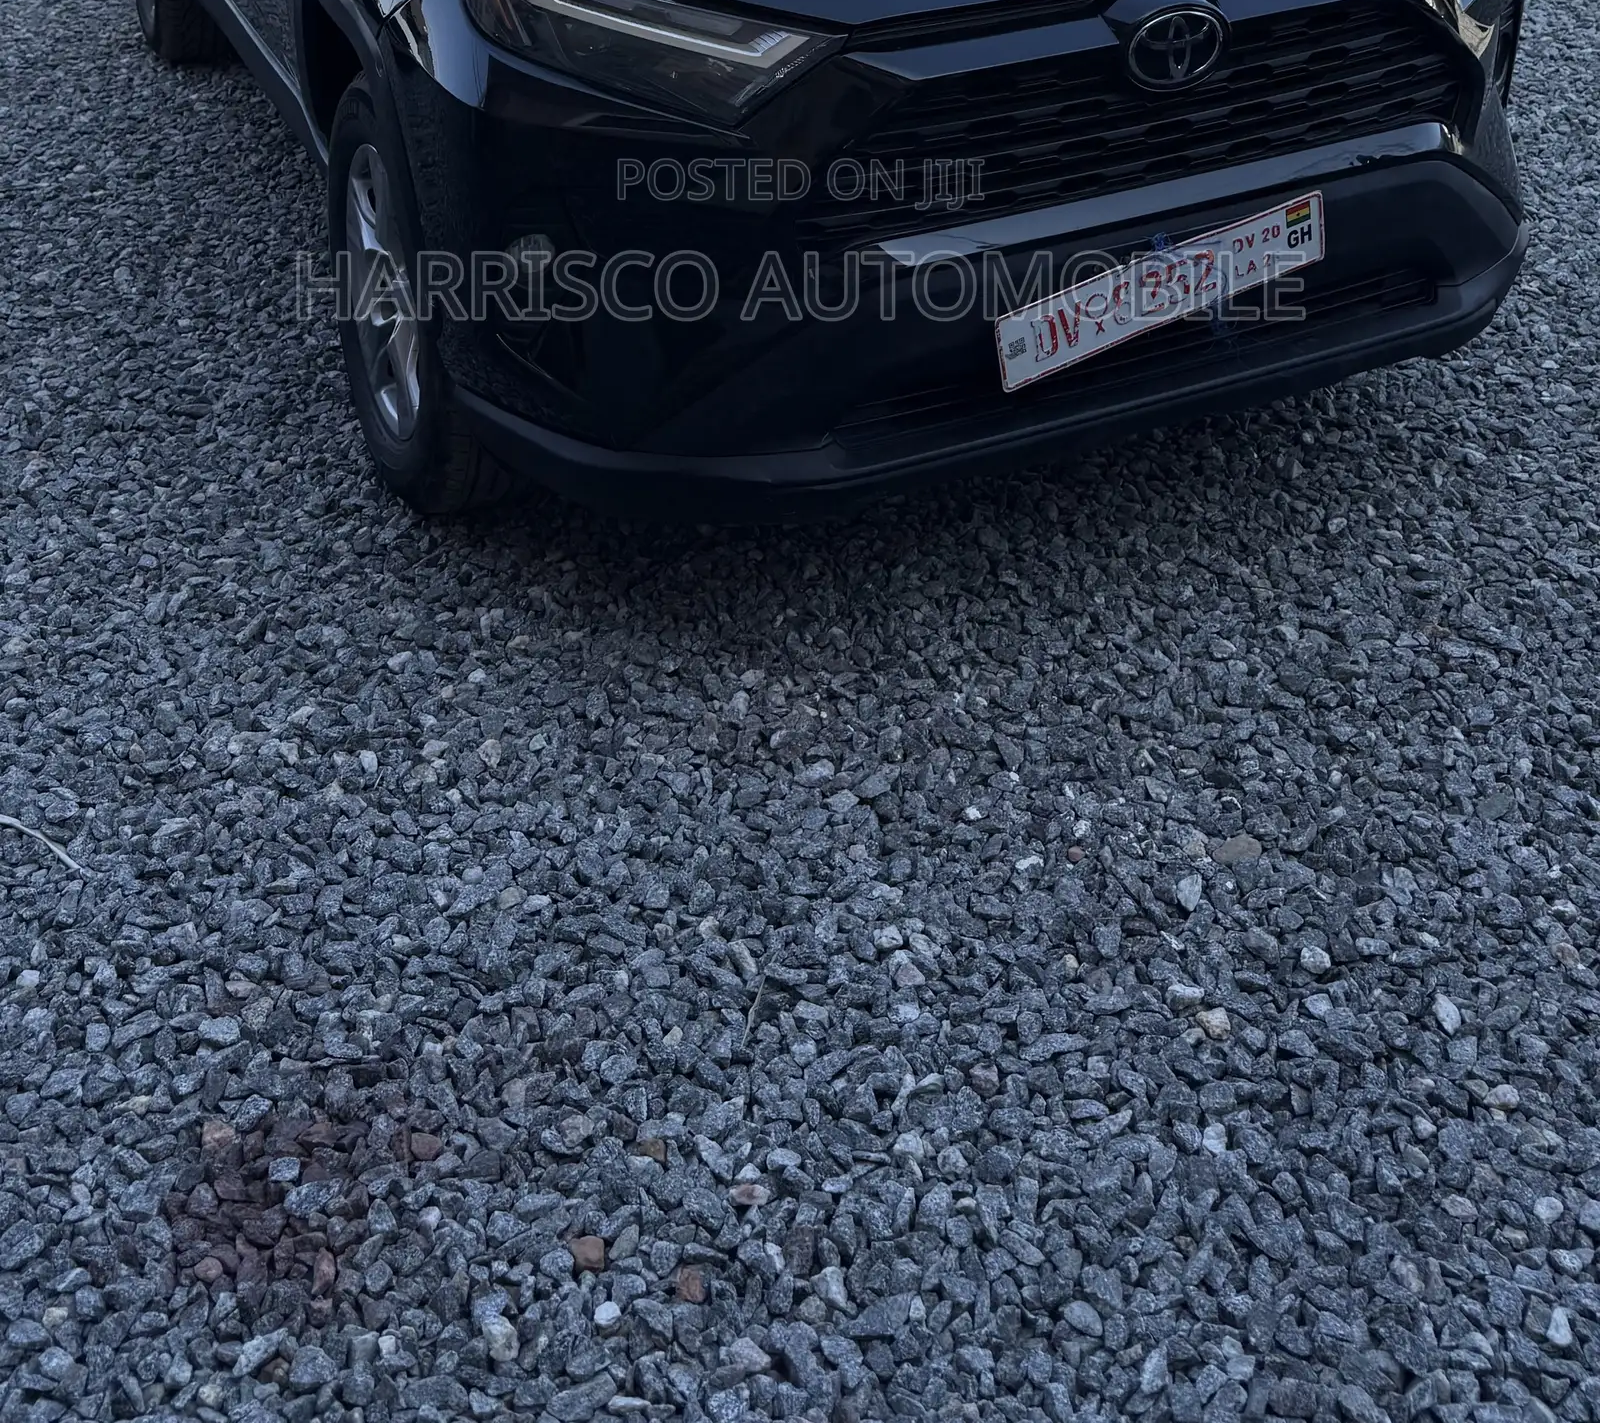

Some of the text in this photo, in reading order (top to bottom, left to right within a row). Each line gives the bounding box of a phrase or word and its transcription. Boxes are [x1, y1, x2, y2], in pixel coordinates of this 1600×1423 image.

[1232, 224, 1281, 254] DV 20
[1286, 223, 1313, 250] GH
[1030, 300, 1081, 363] DV
